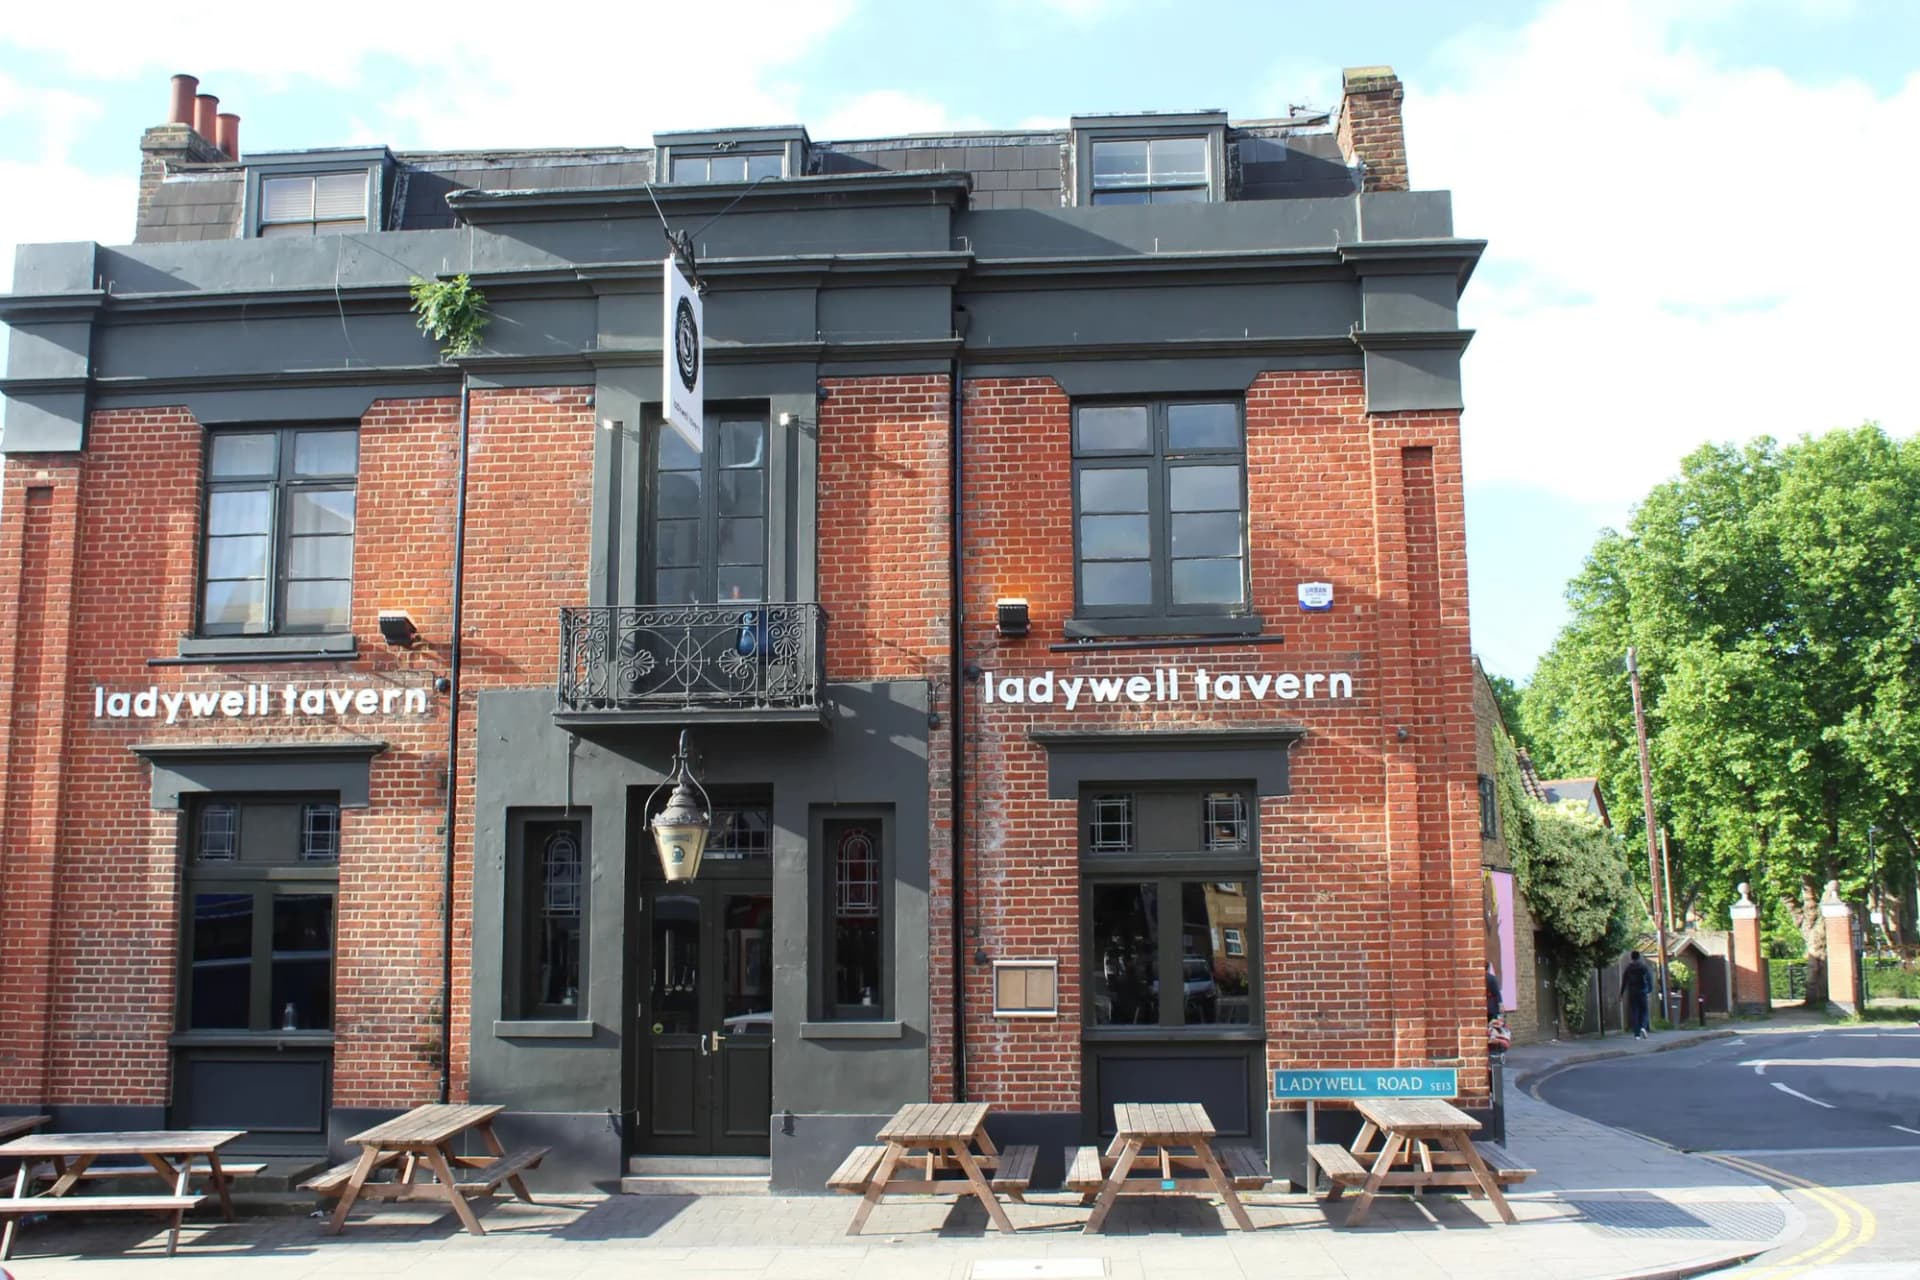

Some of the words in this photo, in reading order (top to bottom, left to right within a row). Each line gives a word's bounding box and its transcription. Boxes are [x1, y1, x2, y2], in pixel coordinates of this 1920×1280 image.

[94, 685, 268, 723] ladywell
[283, 684, 426, 714] tavern
[984, 669, 1178, 710] ladywell
[1195, 668, 1353, 699] tavern
[1279, 1077, 1366, 1091] LADYWELL
[1377, 1076, 1422, 1090] ROAD
[1430, 1082, 1452, 1091] SE13
